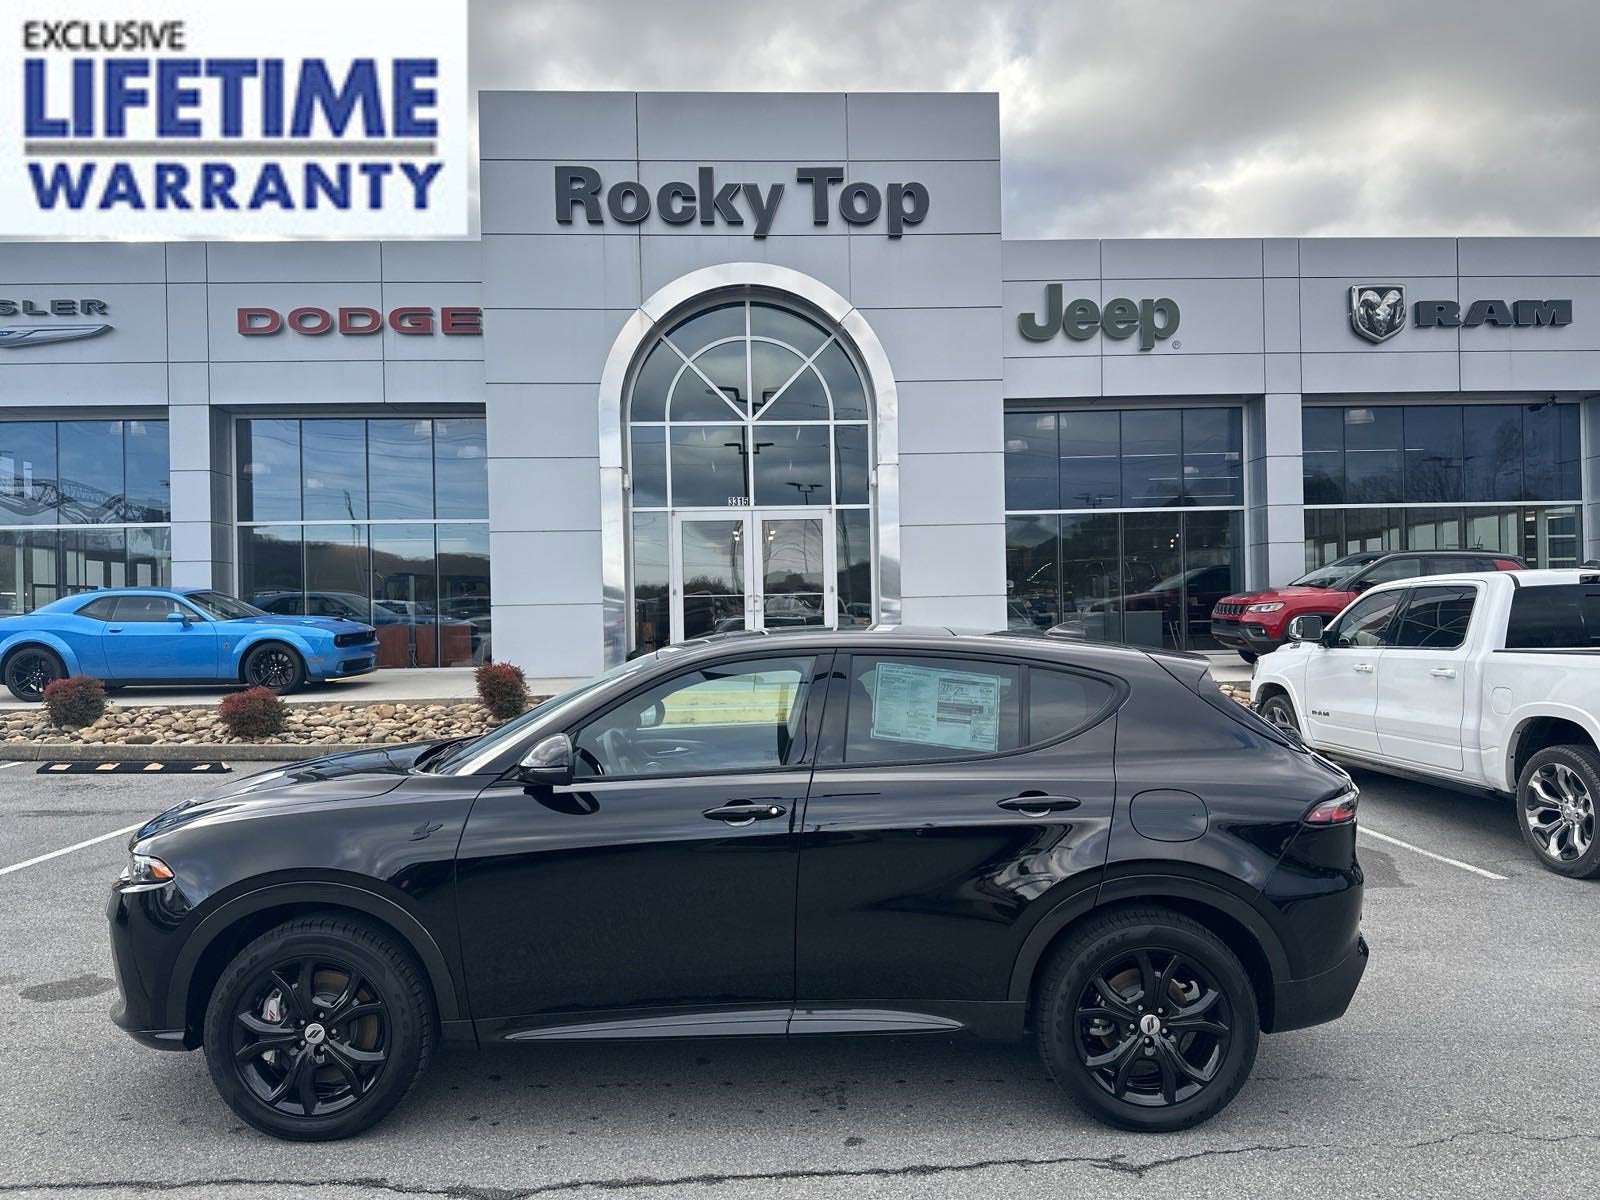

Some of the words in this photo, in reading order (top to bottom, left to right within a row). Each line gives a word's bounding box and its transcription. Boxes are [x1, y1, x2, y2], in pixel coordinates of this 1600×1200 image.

[554, 165, 785, 240] Rocky
[796, 166, 930, 239] Top
[237, 307, 483, 336] DODGE
[1017, 283, 1181, 350] Jeep
[1414, 299, 1573, 328] RAM
